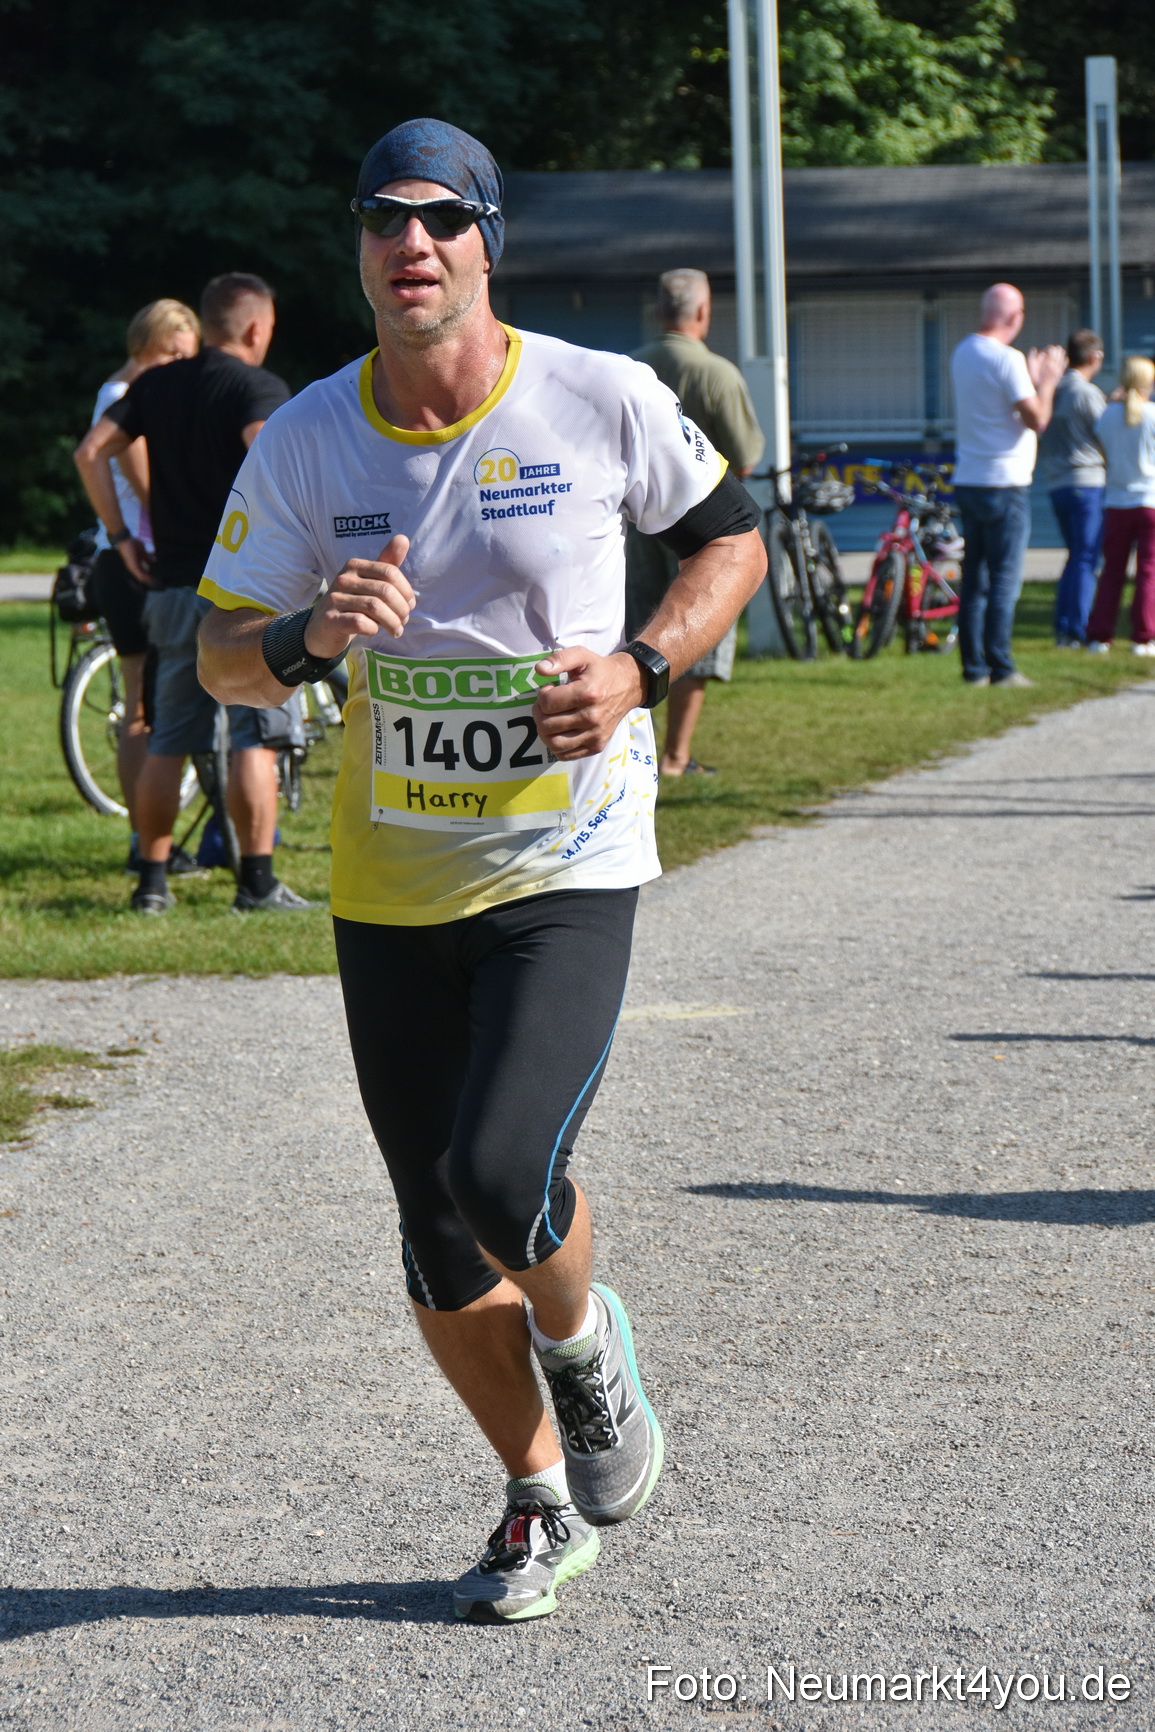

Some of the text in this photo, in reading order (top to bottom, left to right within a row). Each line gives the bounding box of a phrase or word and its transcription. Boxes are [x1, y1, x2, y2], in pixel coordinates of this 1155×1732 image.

[479, 457, 558, 485] 20 JAHRE
[480, 481, 573, 502] Neumarkter
[334, 513, 390, 532] BOCK
[481, 500, 556, 520] Stadtlauf
[379, 664, 540, 699] BOCK
[393, 716, 543, 772] 1402
[407, 779, 488, 818] Harry
[561, 830, 593, 860] 14./15.
